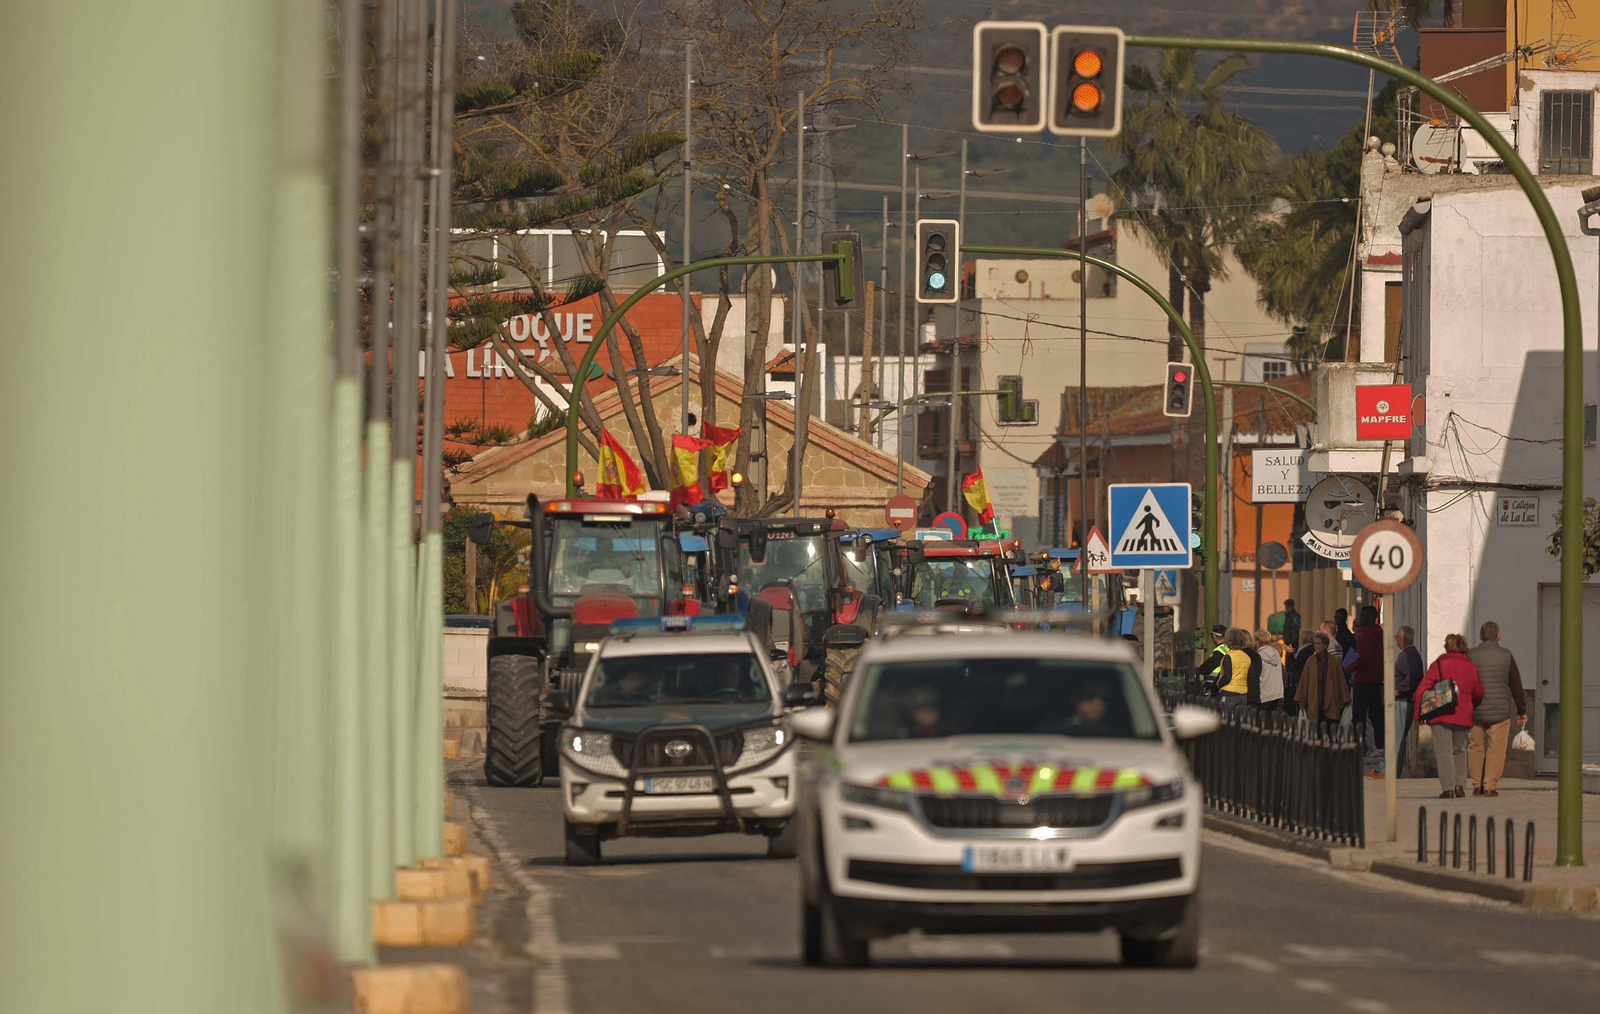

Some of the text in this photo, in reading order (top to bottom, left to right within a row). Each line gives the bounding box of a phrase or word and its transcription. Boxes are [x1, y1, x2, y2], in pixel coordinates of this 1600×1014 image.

[1361, 415, 1406, 424] MAPFRE
[1265, 455, 1305, 466] SALUD
[1281, 468, 1290, 480] Y
[1257, 484, 1312, 495] BELLEZA
[1512, 500, 1536, 512] Callejón
[1501, 512, 1535, 523] de La Luz
[1369, 544, 1404, 570] 40
